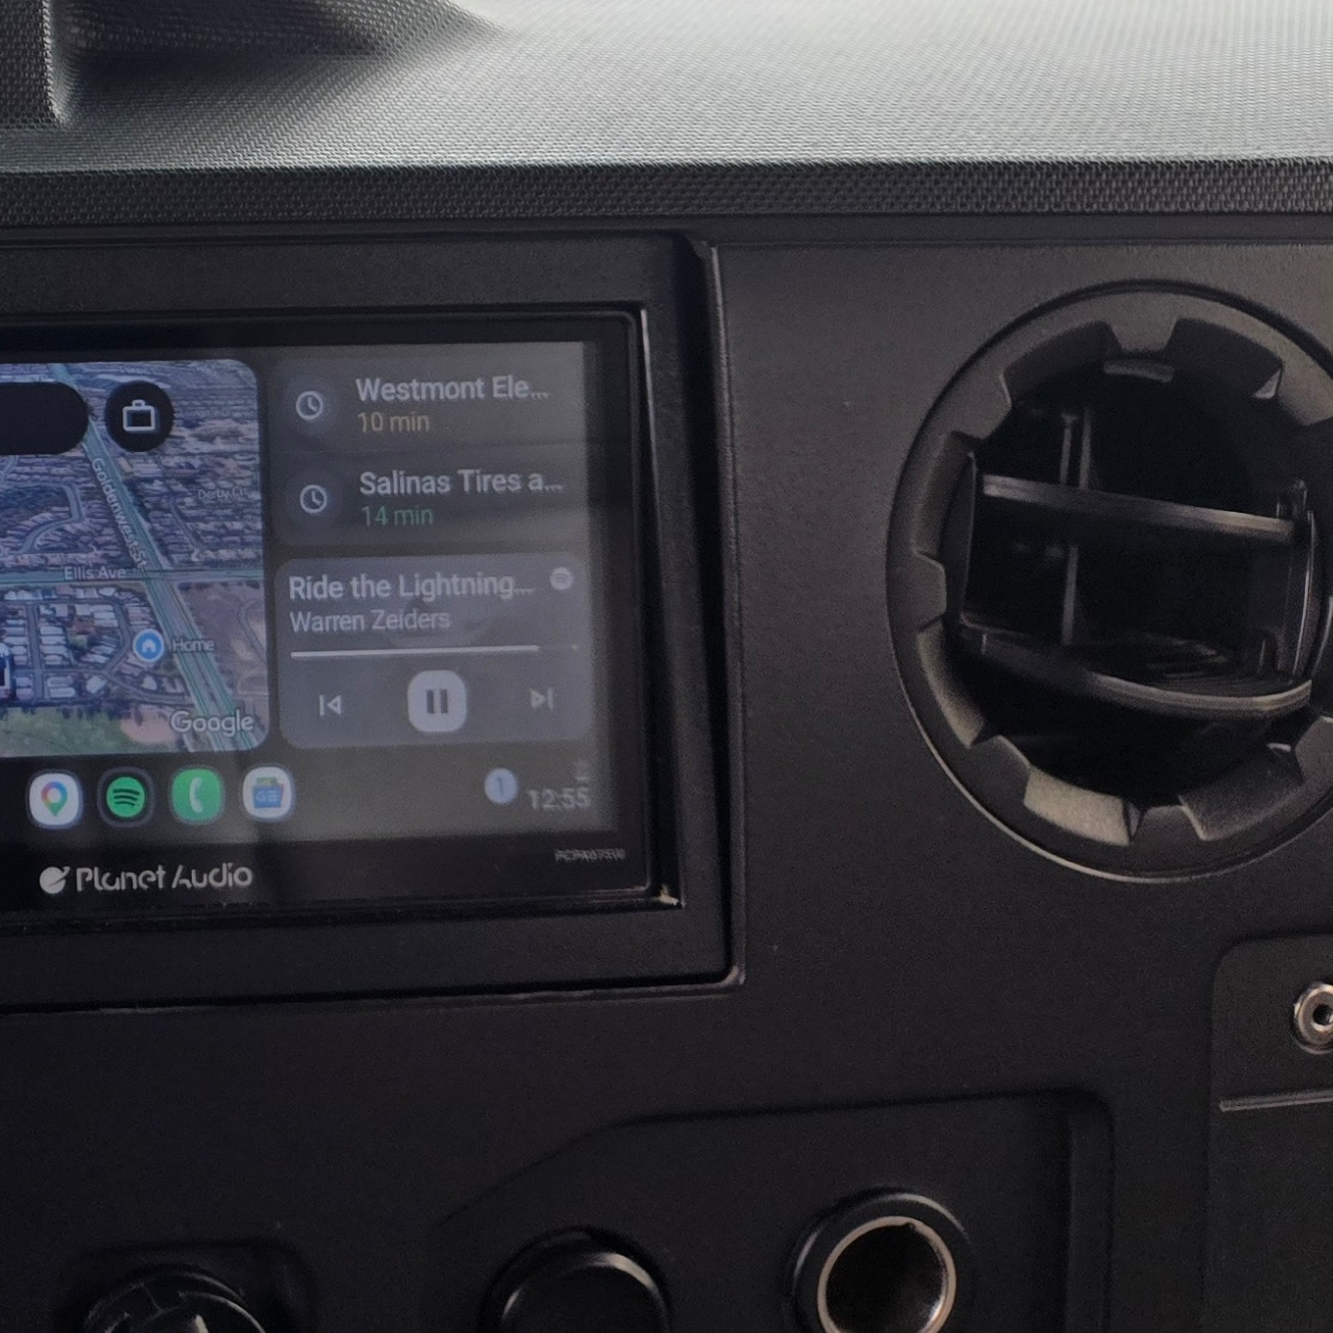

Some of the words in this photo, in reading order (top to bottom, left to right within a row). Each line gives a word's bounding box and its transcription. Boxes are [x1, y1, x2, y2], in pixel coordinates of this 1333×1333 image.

[356, 377, 485, 402] Westmont
[357, 412, 383, 433] 10
[389, 411, 430, 433] min
[359, 470, 451, 495] Salinas
[457, 469, 522, 492] Tires
[362, 506, 388, 526] 14
[393, 505, 434, 526] min
[64, 566, 94, 580] Ellis
[97, 566, 126, 578] Ave
[289, 575, 344, 600] Ride
[349, 573, 391, 597] the
[289, 611, 364, 633] Warren
[371, 609, 451, 631] Zeiders
[171, 640, 215, 652] Home
[170, 711, 254, 738] Google
[76, 864, 166, 892] Planet
[172, 862, 253, 888] Audio
